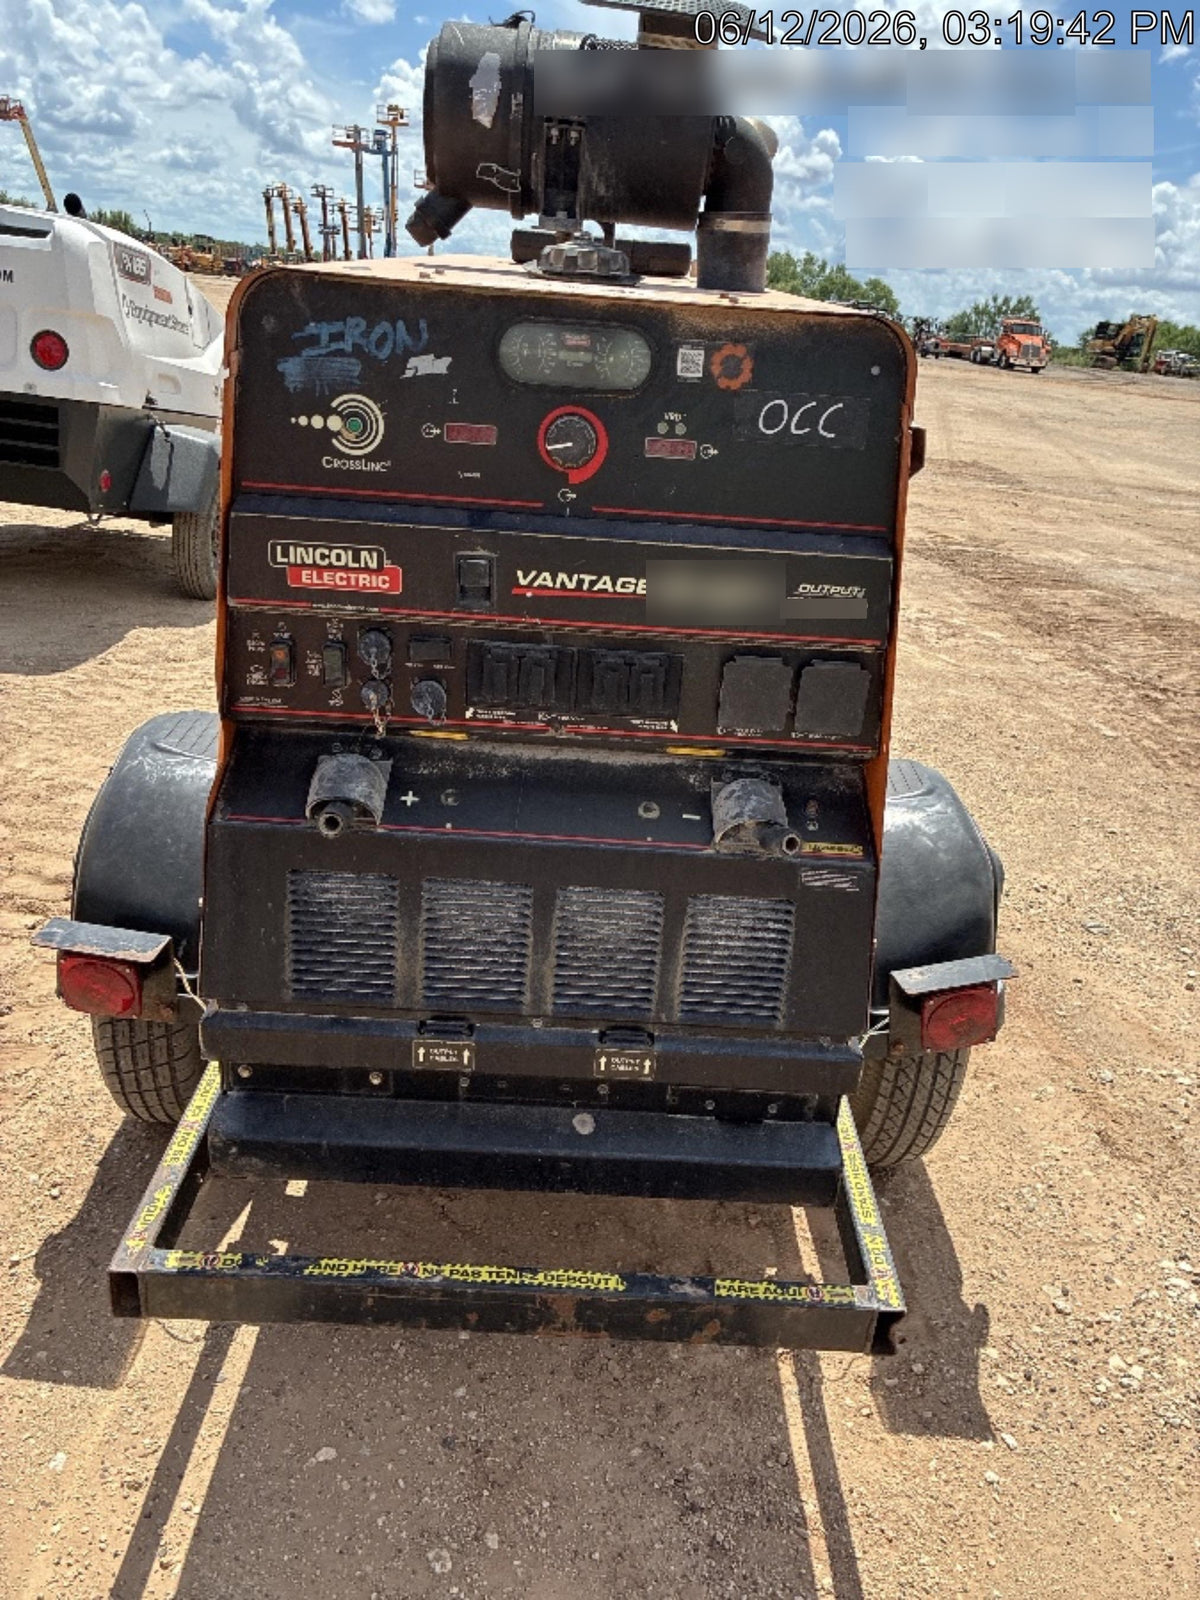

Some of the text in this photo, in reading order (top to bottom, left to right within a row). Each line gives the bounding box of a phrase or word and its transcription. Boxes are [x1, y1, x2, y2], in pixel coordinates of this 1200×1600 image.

[0, 269, 14, 283] M
[291, 316, 428, 360] IRON
[758, 399, 844, 438] OCC
[276, 545, 378, 570] LINCOLN
[301, 570, 390, 589] ELECTRIC
[517, 569, 646, 595] VANTAGE
